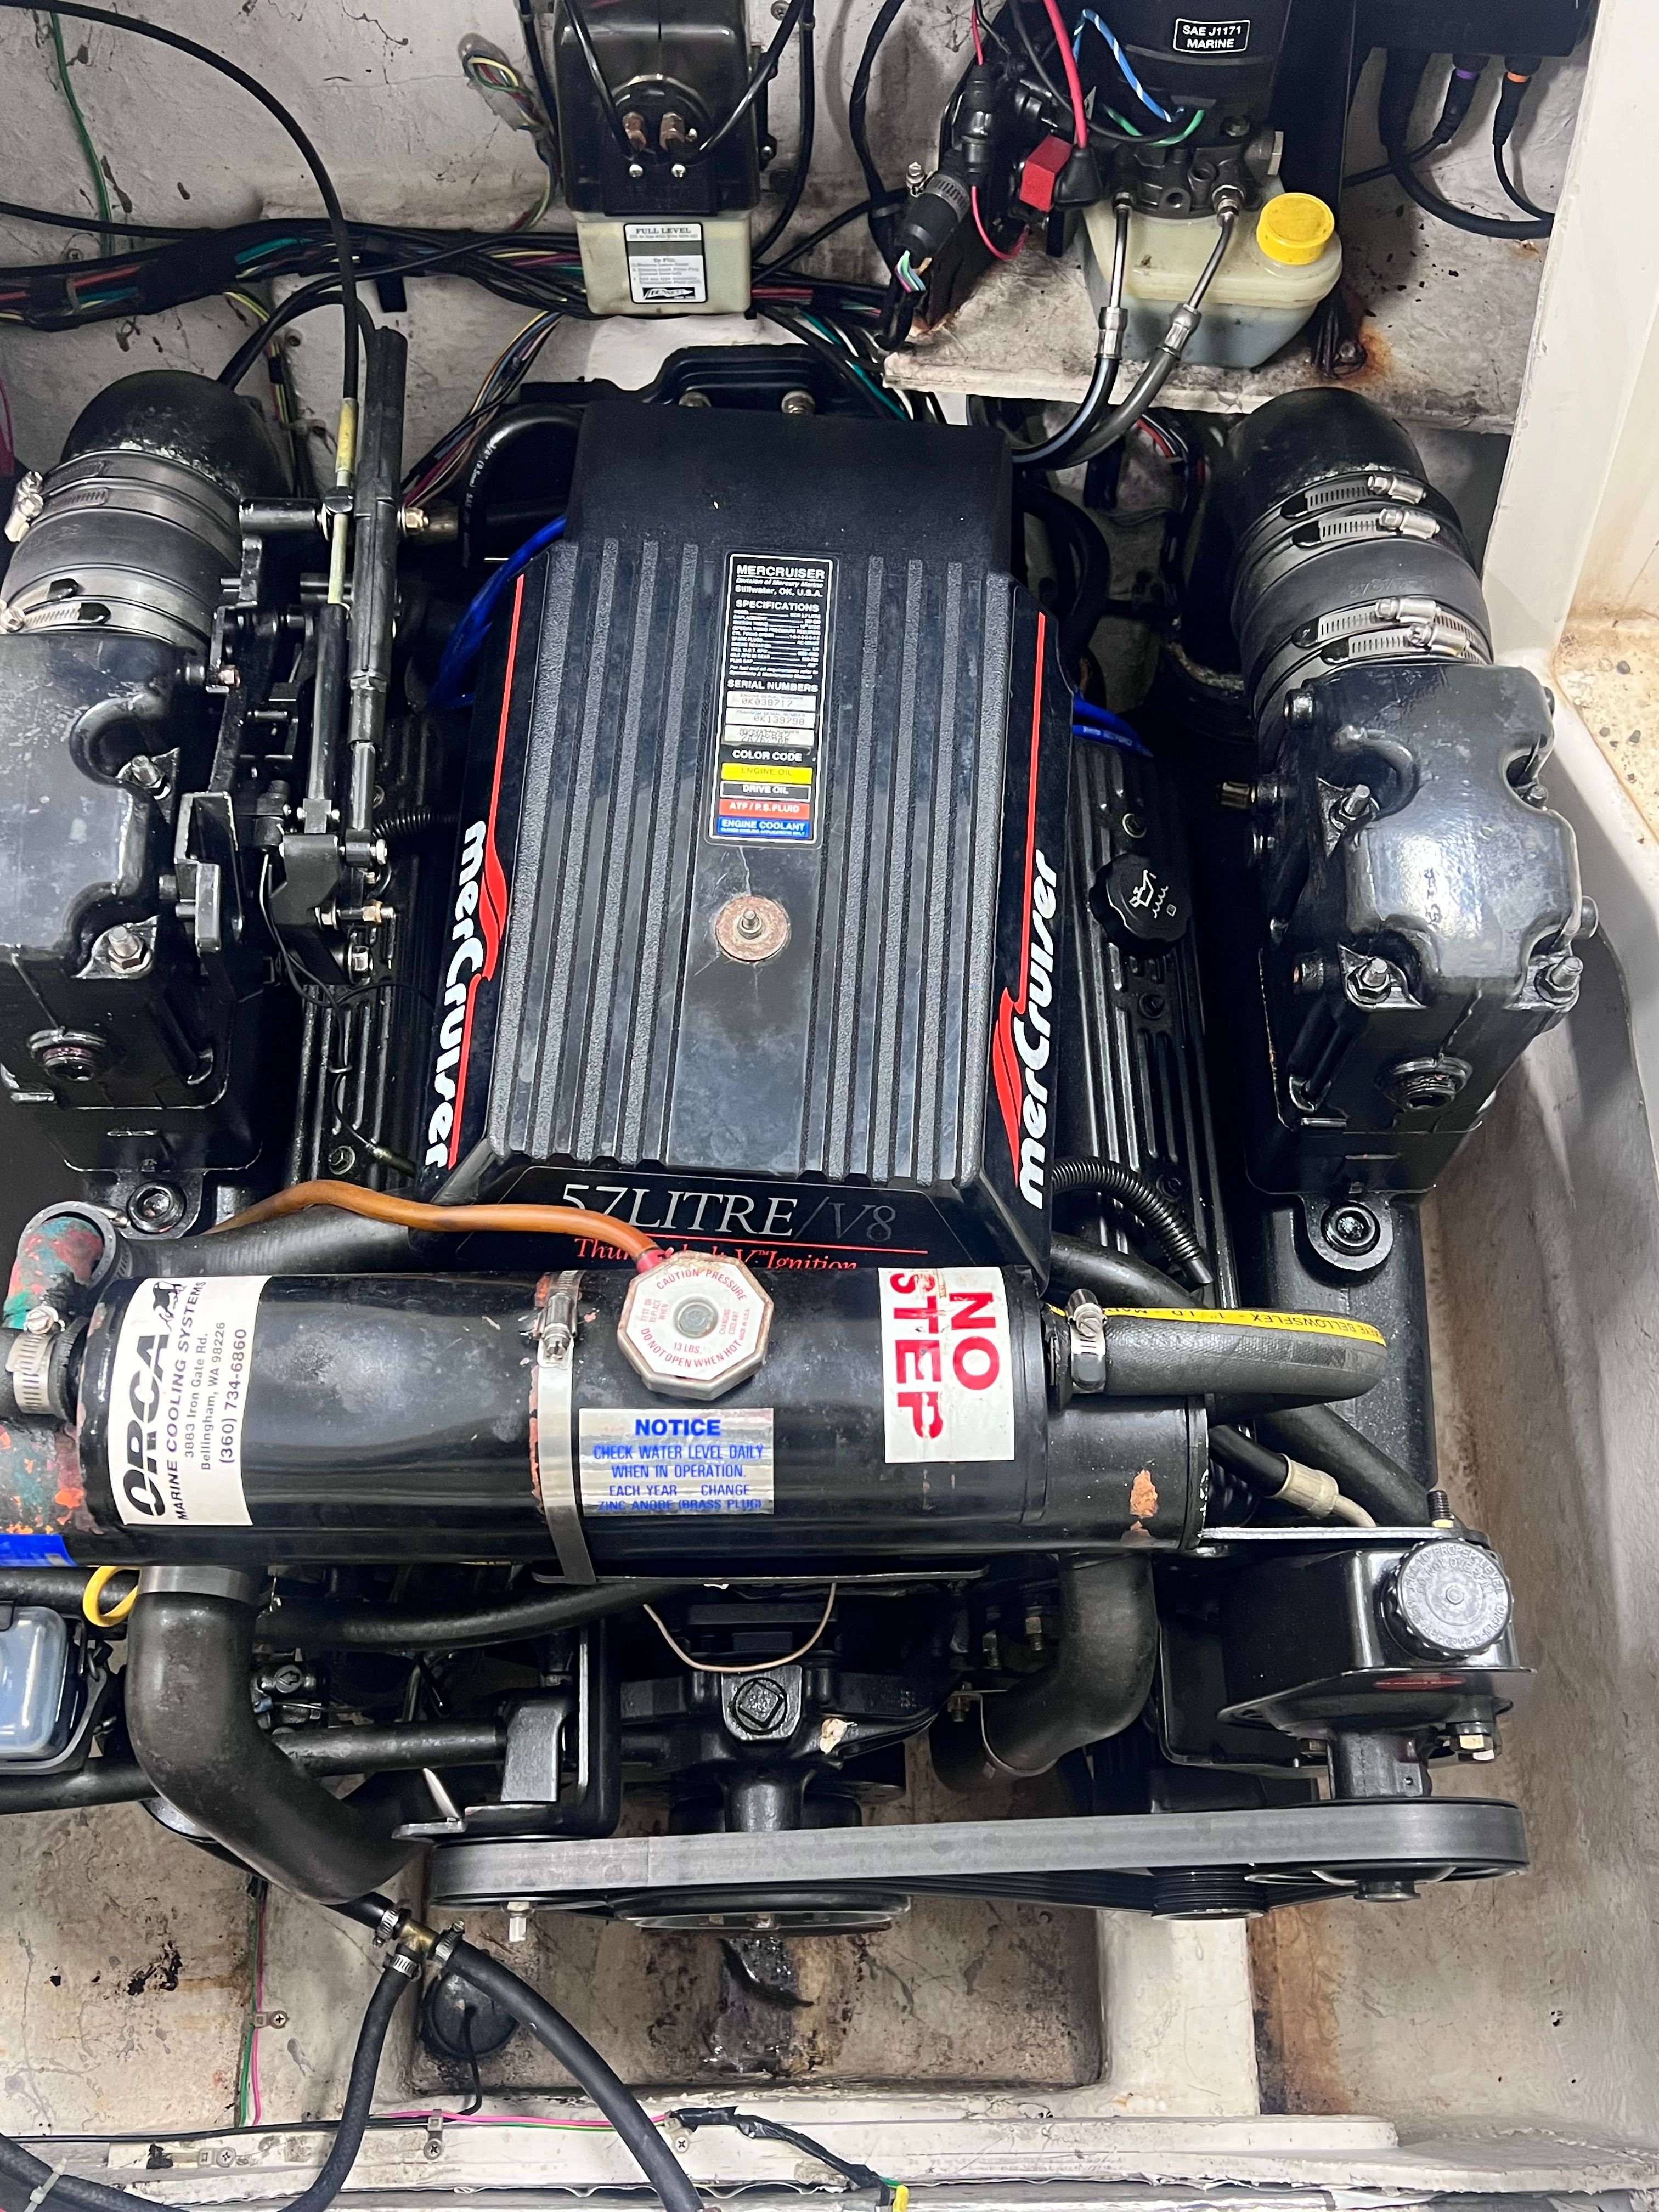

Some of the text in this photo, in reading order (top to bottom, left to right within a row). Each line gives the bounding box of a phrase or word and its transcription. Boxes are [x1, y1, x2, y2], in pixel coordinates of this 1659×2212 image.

[1182, 25, 1242, 36] SAE J1171
[1187, 38, 1234, 49] MARINE
[736, 565, 825, 579] MERCRUISER
[778, 586, 795, 596] OK,
[797, 588, 823, 597] U.S.A.
[736, 599, 820, 612] SPECIFICATIONS
[727, 679, 819, 692] SERIAL NUMBERS
[732, 749, 802, 763] COLOR CODE
[741, 767, 792, 776] ENGINE OIL
[742, 784, 789, 795] DRIVE OIL
[729, 802, 747, 810] ATF
[772, 804, 799, 812] FLUID
[721, 819, 805, 831] ENGINE COOLANT
[657, 1269, 747, 1301] CAUTION PRESSURE
[658, 1304, 668, 1320] WHEN
[1251, 1313, 1357, 1333] BELLOWSFLEX
[641, 1327, 742, 1368] DO NOT OPEN WHEN HOT
[949, 1292, 1000, 1390] NO
[673, 1342, 702, 1355] 13 LBS.
[889, 1273, 944, 1439] STEP
[166, 1281, 207, 1521] MARINE COOLING SYSTEMS
[184, 1333, 208, 1459] 3883 Iron Gate Rd.
[201, 1322, 226, 1471] Bellingham, WA 98226
[219, 1329, 247, 1465] (360) 734-6860
[123, 1334, 170, 1517] ORCA
[634, 1418, 721, 1437] NOTICE
[594, 1444, 764, 1459] CHECK WATER LEVEL DAILY
[611, 1464, 747, 1478] WHEN IN OPERATION.
[609, 1484, 751, 1496] EACH YEAR CHANGE
[1432, 1544, 1478, 1561] PROPER
[1477, 1556, 1506, 1595] LEVEL
